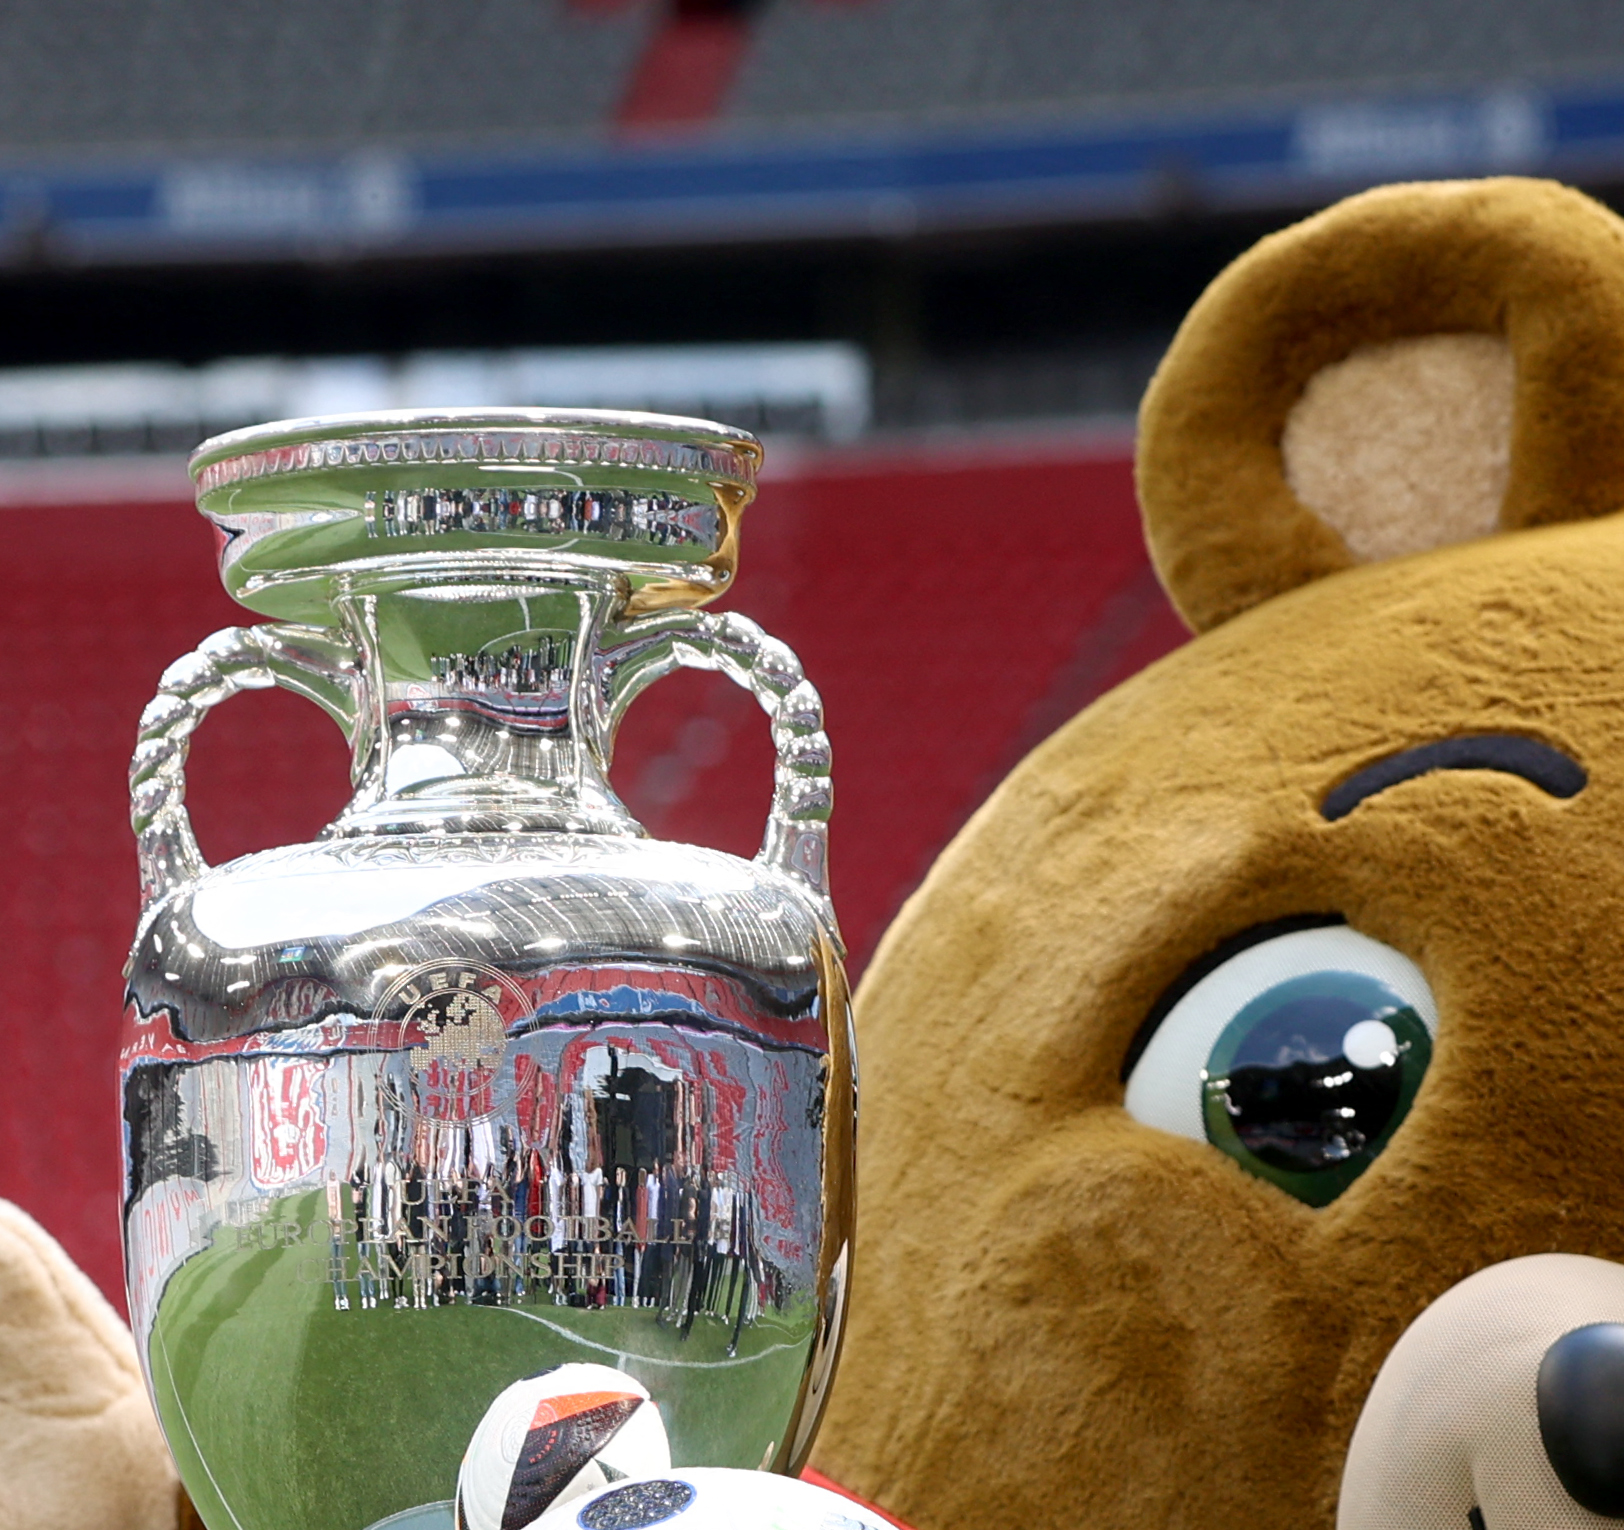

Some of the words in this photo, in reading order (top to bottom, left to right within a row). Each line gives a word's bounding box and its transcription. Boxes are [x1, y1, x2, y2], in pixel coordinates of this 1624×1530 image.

[398, 971, 503, 1005] UEFA
[399, 1177, 515, 1206] UEFA
[234, 1215, 453, 1250] EUROPEAN
[465, 1214, 694, 1245] FOOTBALL
[296, 1252, 625, 1283] CHAMPIONSHIP
